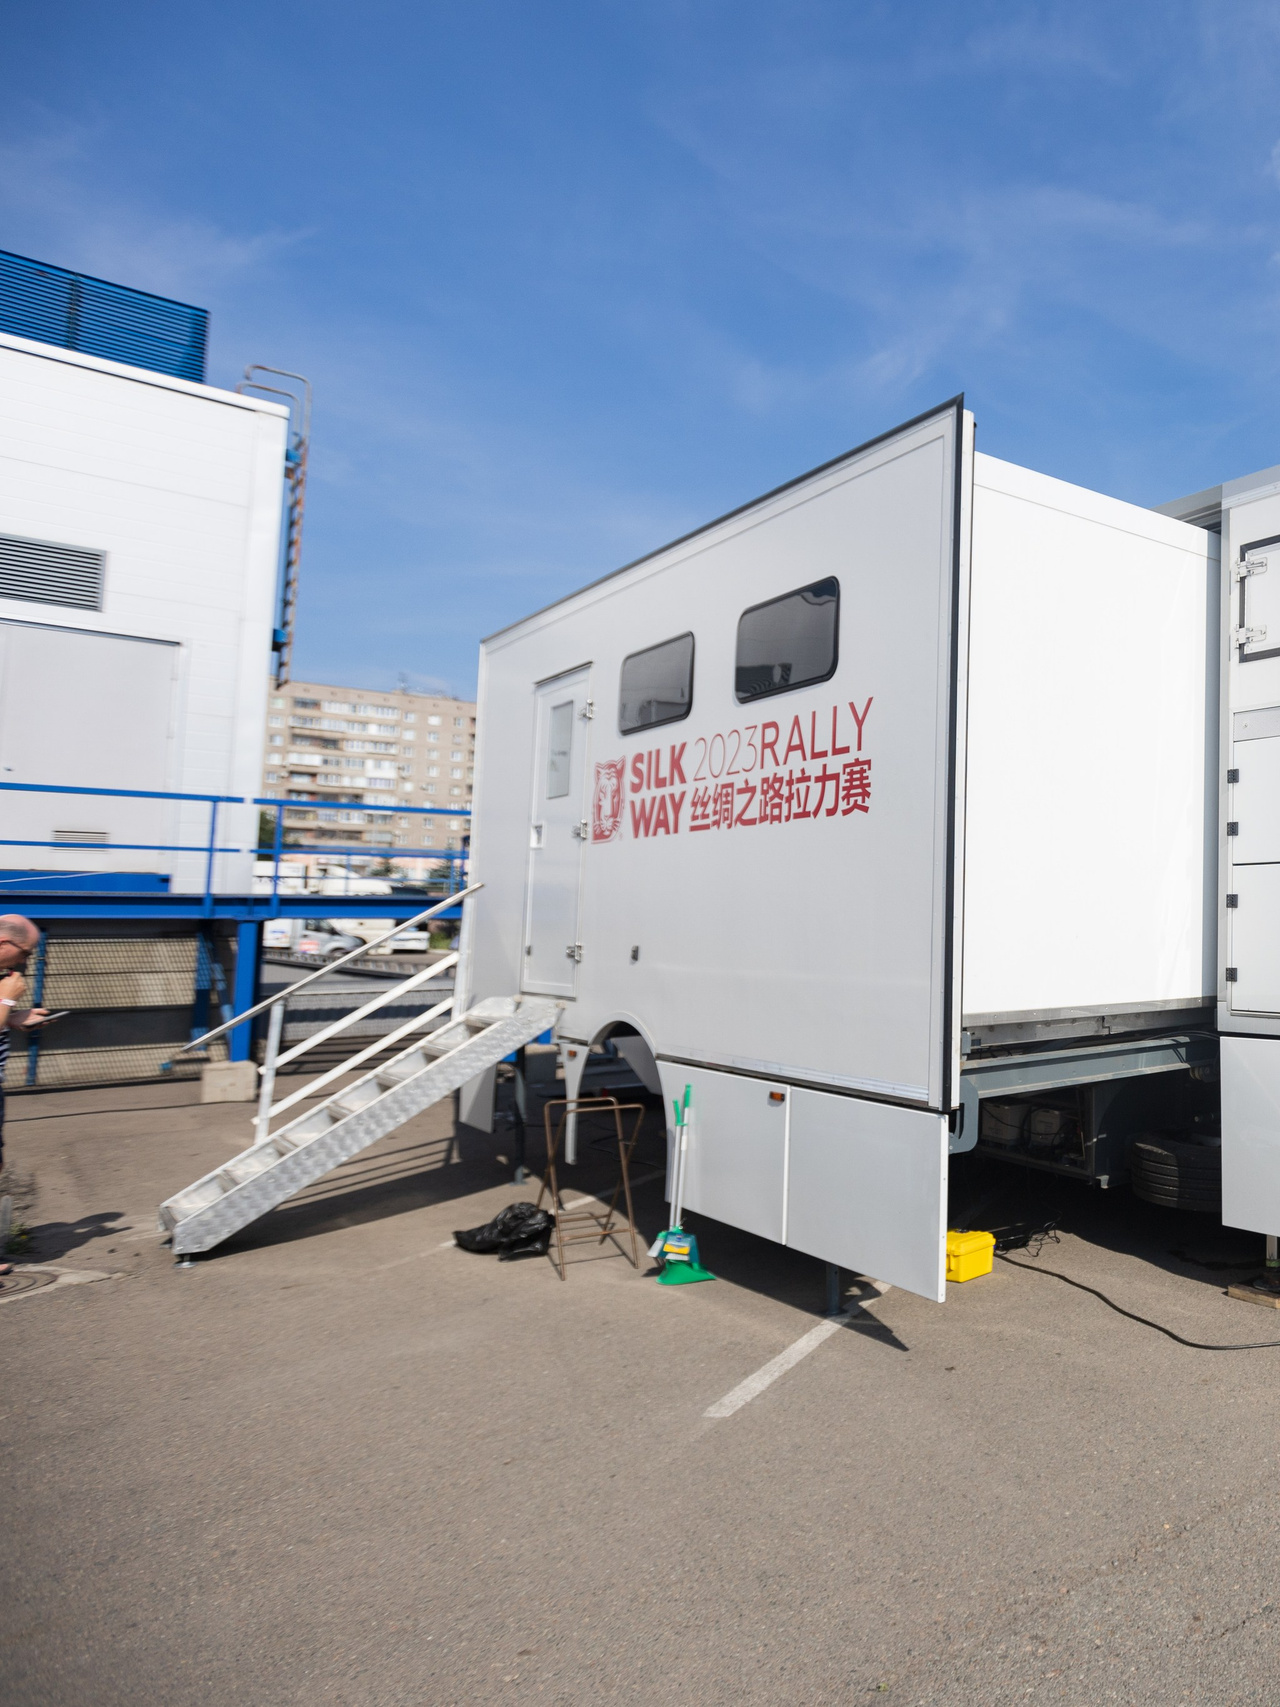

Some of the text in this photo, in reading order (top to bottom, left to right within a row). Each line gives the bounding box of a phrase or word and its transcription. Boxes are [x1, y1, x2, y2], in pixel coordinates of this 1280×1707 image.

[629, 742, 687, 794] SILK
[629, 757, 873, 839] WAY 丝绸之路拉力赛
